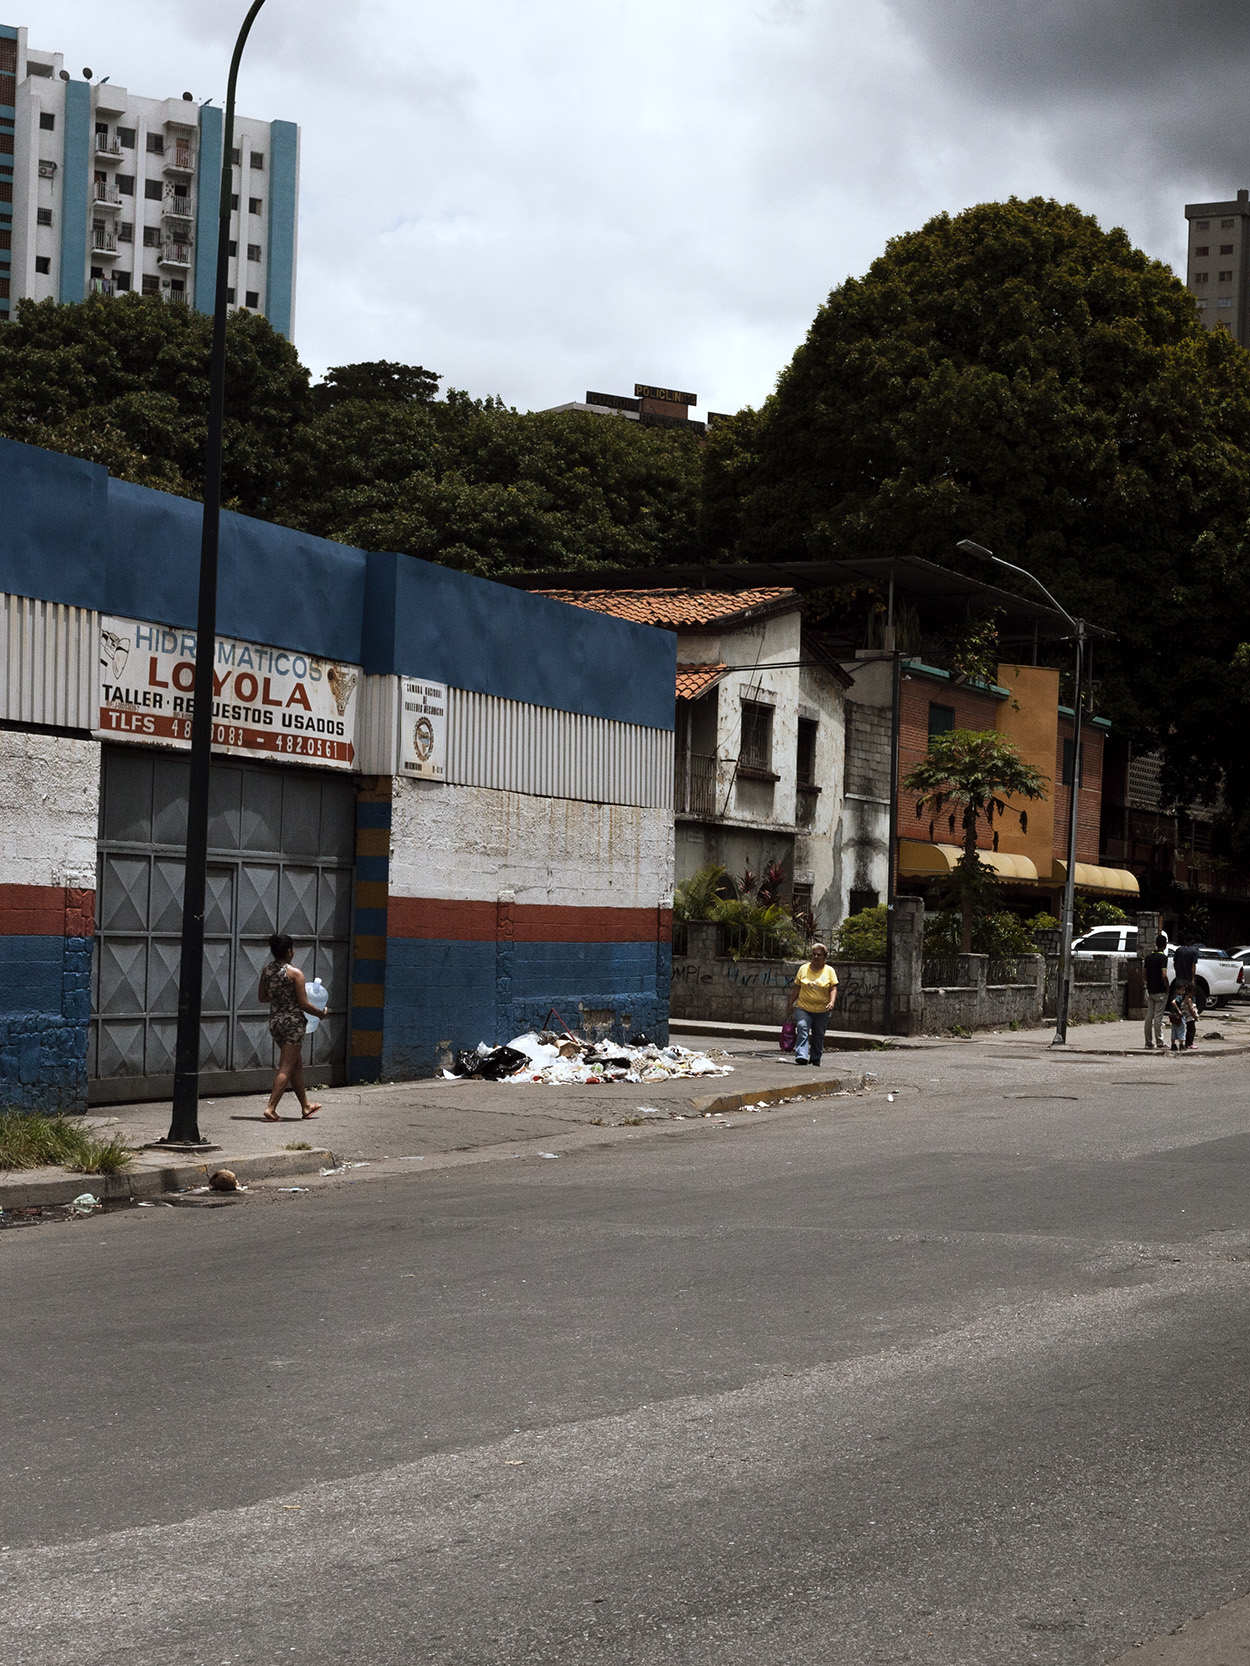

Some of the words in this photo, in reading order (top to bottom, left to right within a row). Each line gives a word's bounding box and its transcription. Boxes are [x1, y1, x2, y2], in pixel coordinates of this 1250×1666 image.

[136, 625, 322, 682] HIDRMATICOS
[102, 684, 163, 709] TALLER
[173, 696, 273, 726] REUESTOS
[282, 713, 345, 736] USADOS
[148, 656, 312, 712] LOYOLA
[109, 711, 155, 733] TLFS
[275, 735, 338, 759] 482.0561
